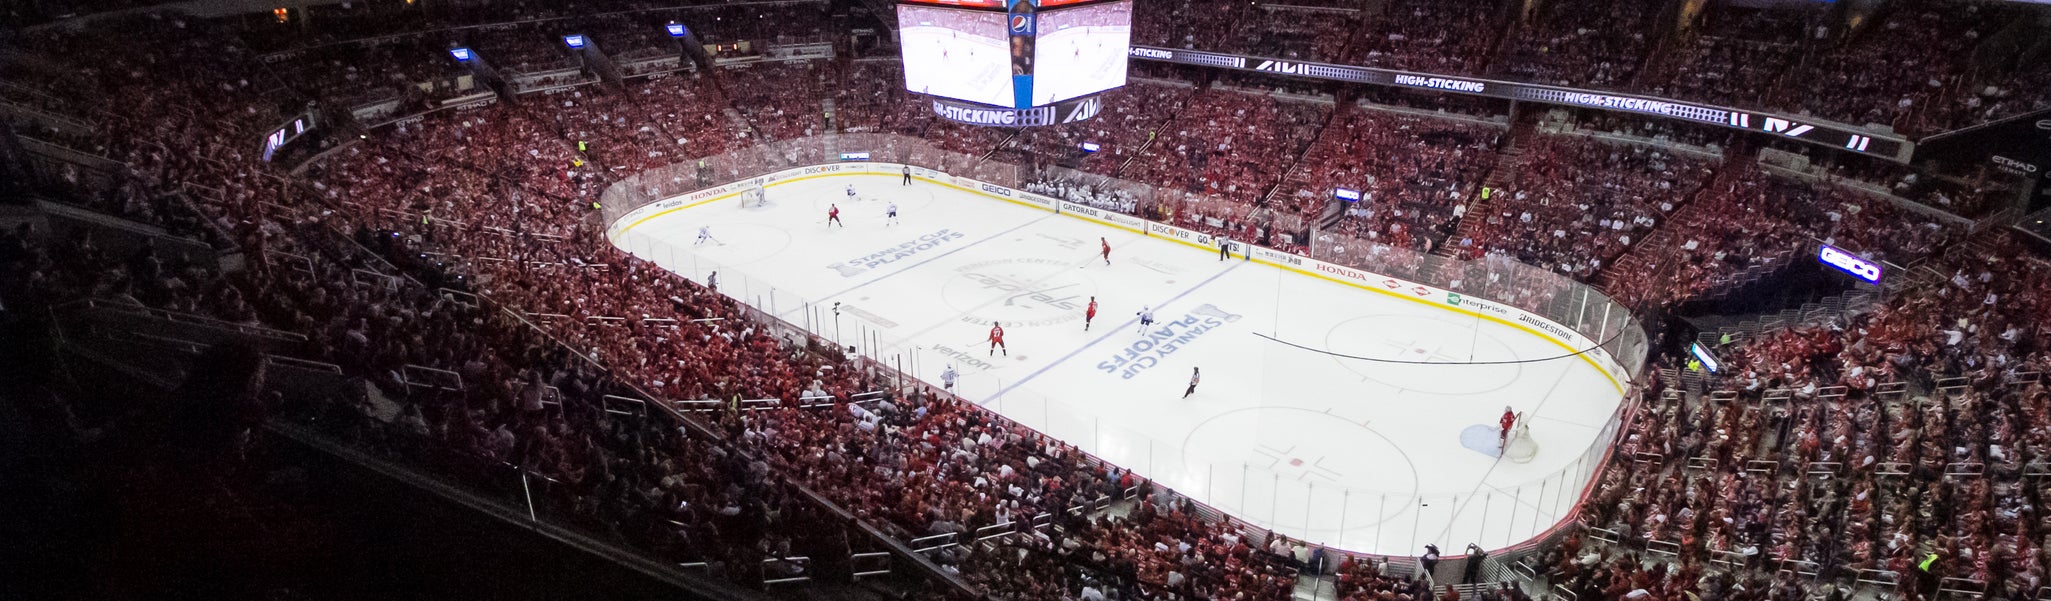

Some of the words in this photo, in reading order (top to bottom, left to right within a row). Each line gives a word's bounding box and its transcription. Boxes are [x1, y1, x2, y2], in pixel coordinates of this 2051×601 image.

[1395, 74, 1485, 93] HIGH-STICKING
[1564, 92, 1672, 115] HIGH-STICKING
[1992, 155, 2037, 172] ETIHAD
[691, 187, 727, 201] HONDA
[982, 182, 1011, 197] GEICO
[663, 199, 682, 209] leidos
[1063, 203, 1098, 218] GATORADE
[1152, 223, 1189, 240] DISCOVER
[849, 238, 917, 265] STANLEY
[867, 231, 966, 269] PLAYOFFS
[1316, 263, 1367, 282] HONDA
[1821, 247, 1880, 281] GEICO
[1156, 317, 1223, 358] STANLEY
[1519, 313, 1573, 341] BRIDGESTONE
[1097, 314, 1200, 373] PLAYOFFS
[932, 343, 992, 370] verizon
[1122, 356, 1158, 380] CUP
